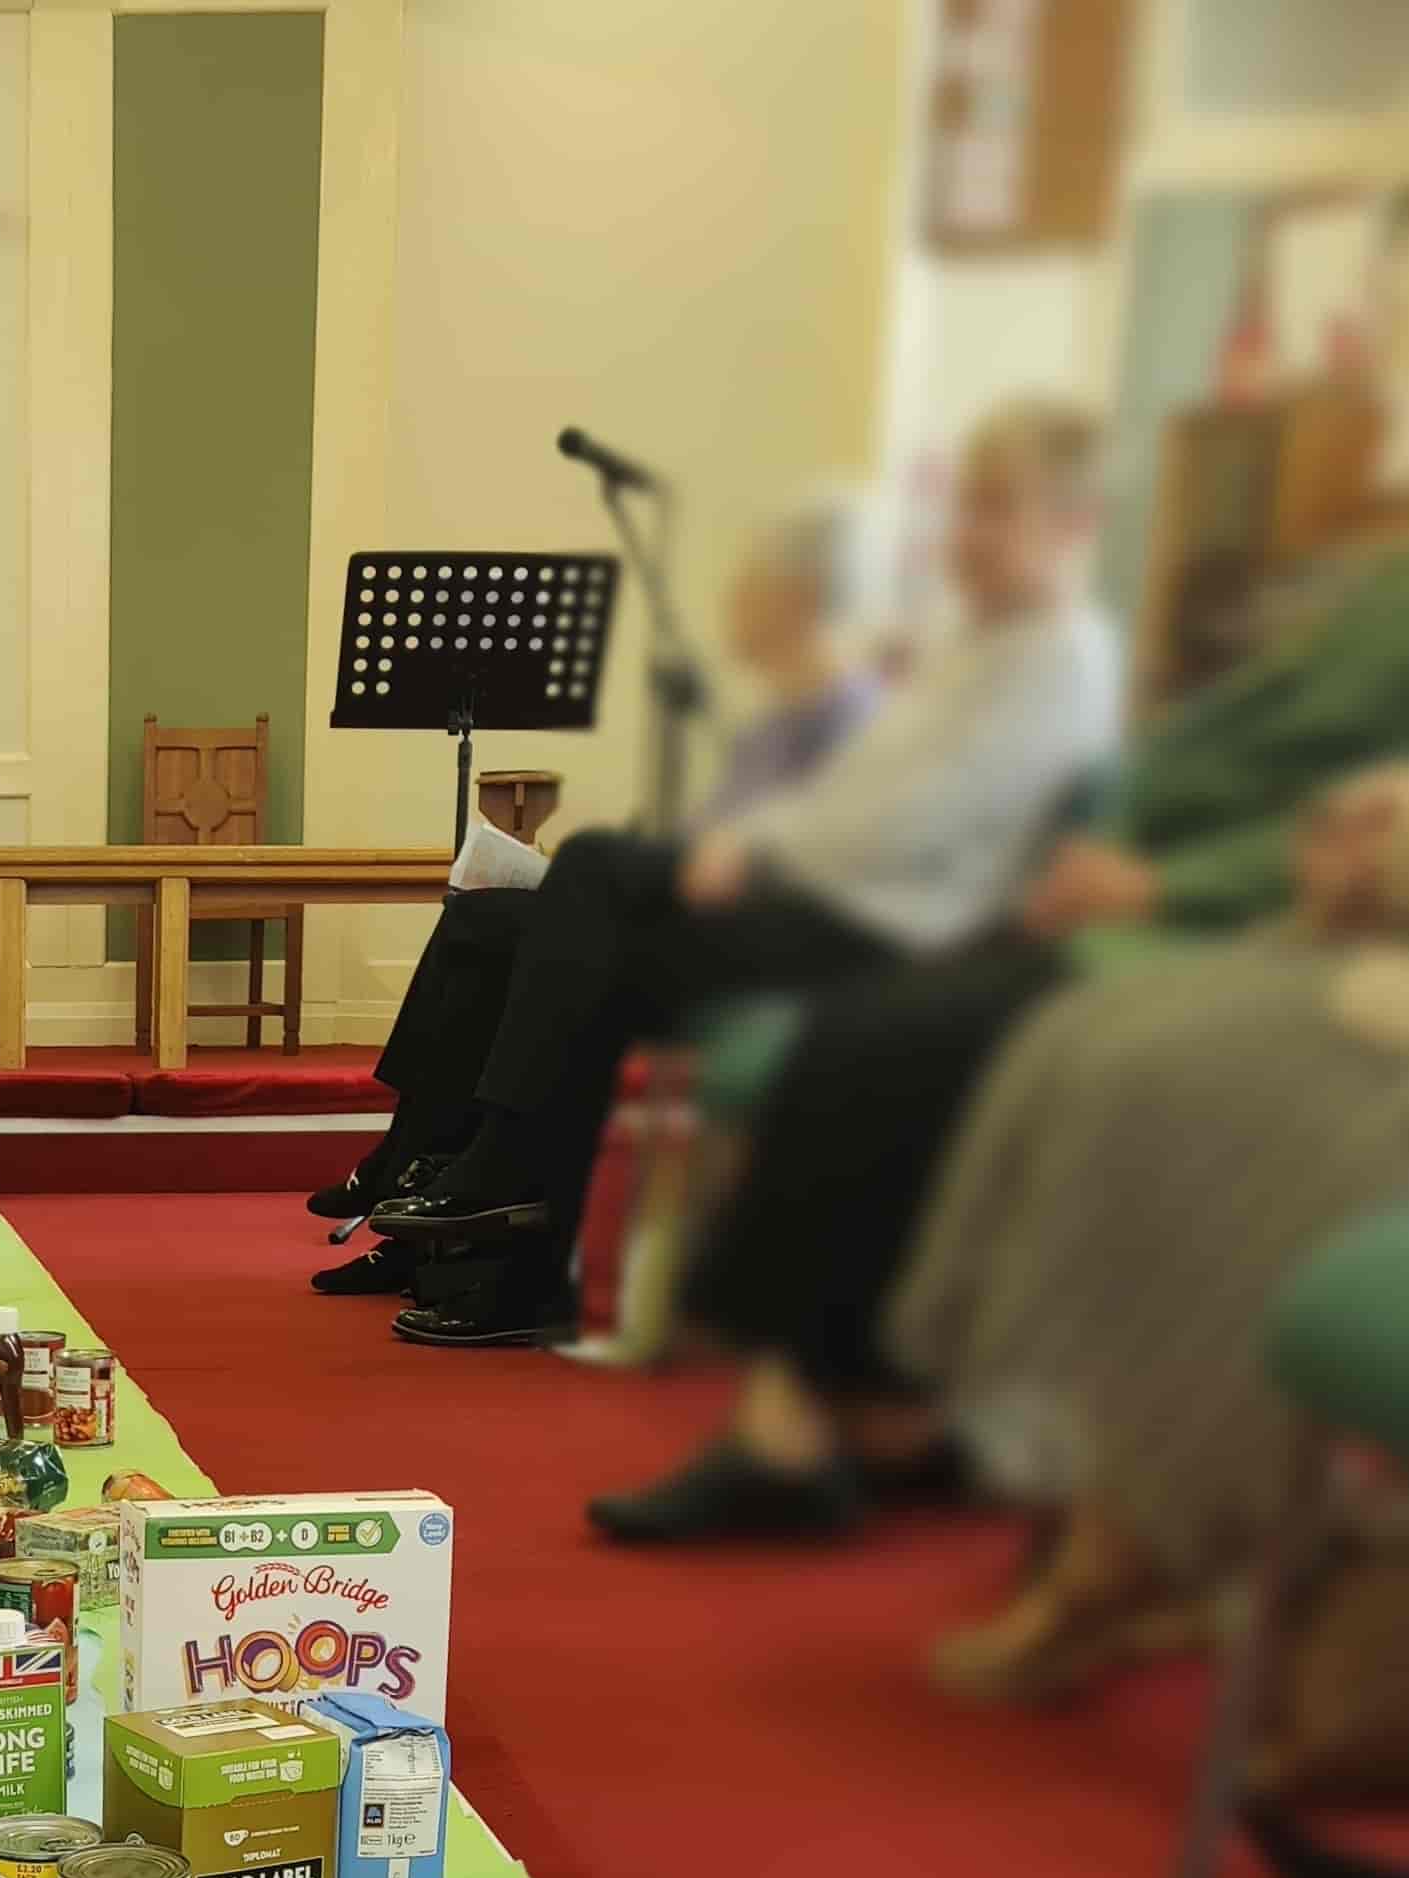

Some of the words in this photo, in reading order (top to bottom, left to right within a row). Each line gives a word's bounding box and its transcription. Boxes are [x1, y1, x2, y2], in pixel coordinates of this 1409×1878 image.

[212, 1574, 298, 1621] Golden
[304, 1565, 390, 1613] Bridge
[182, 1619, 422, 1700] HOOPS
[243, 1848, 282, 1864] DIPLOMAT
